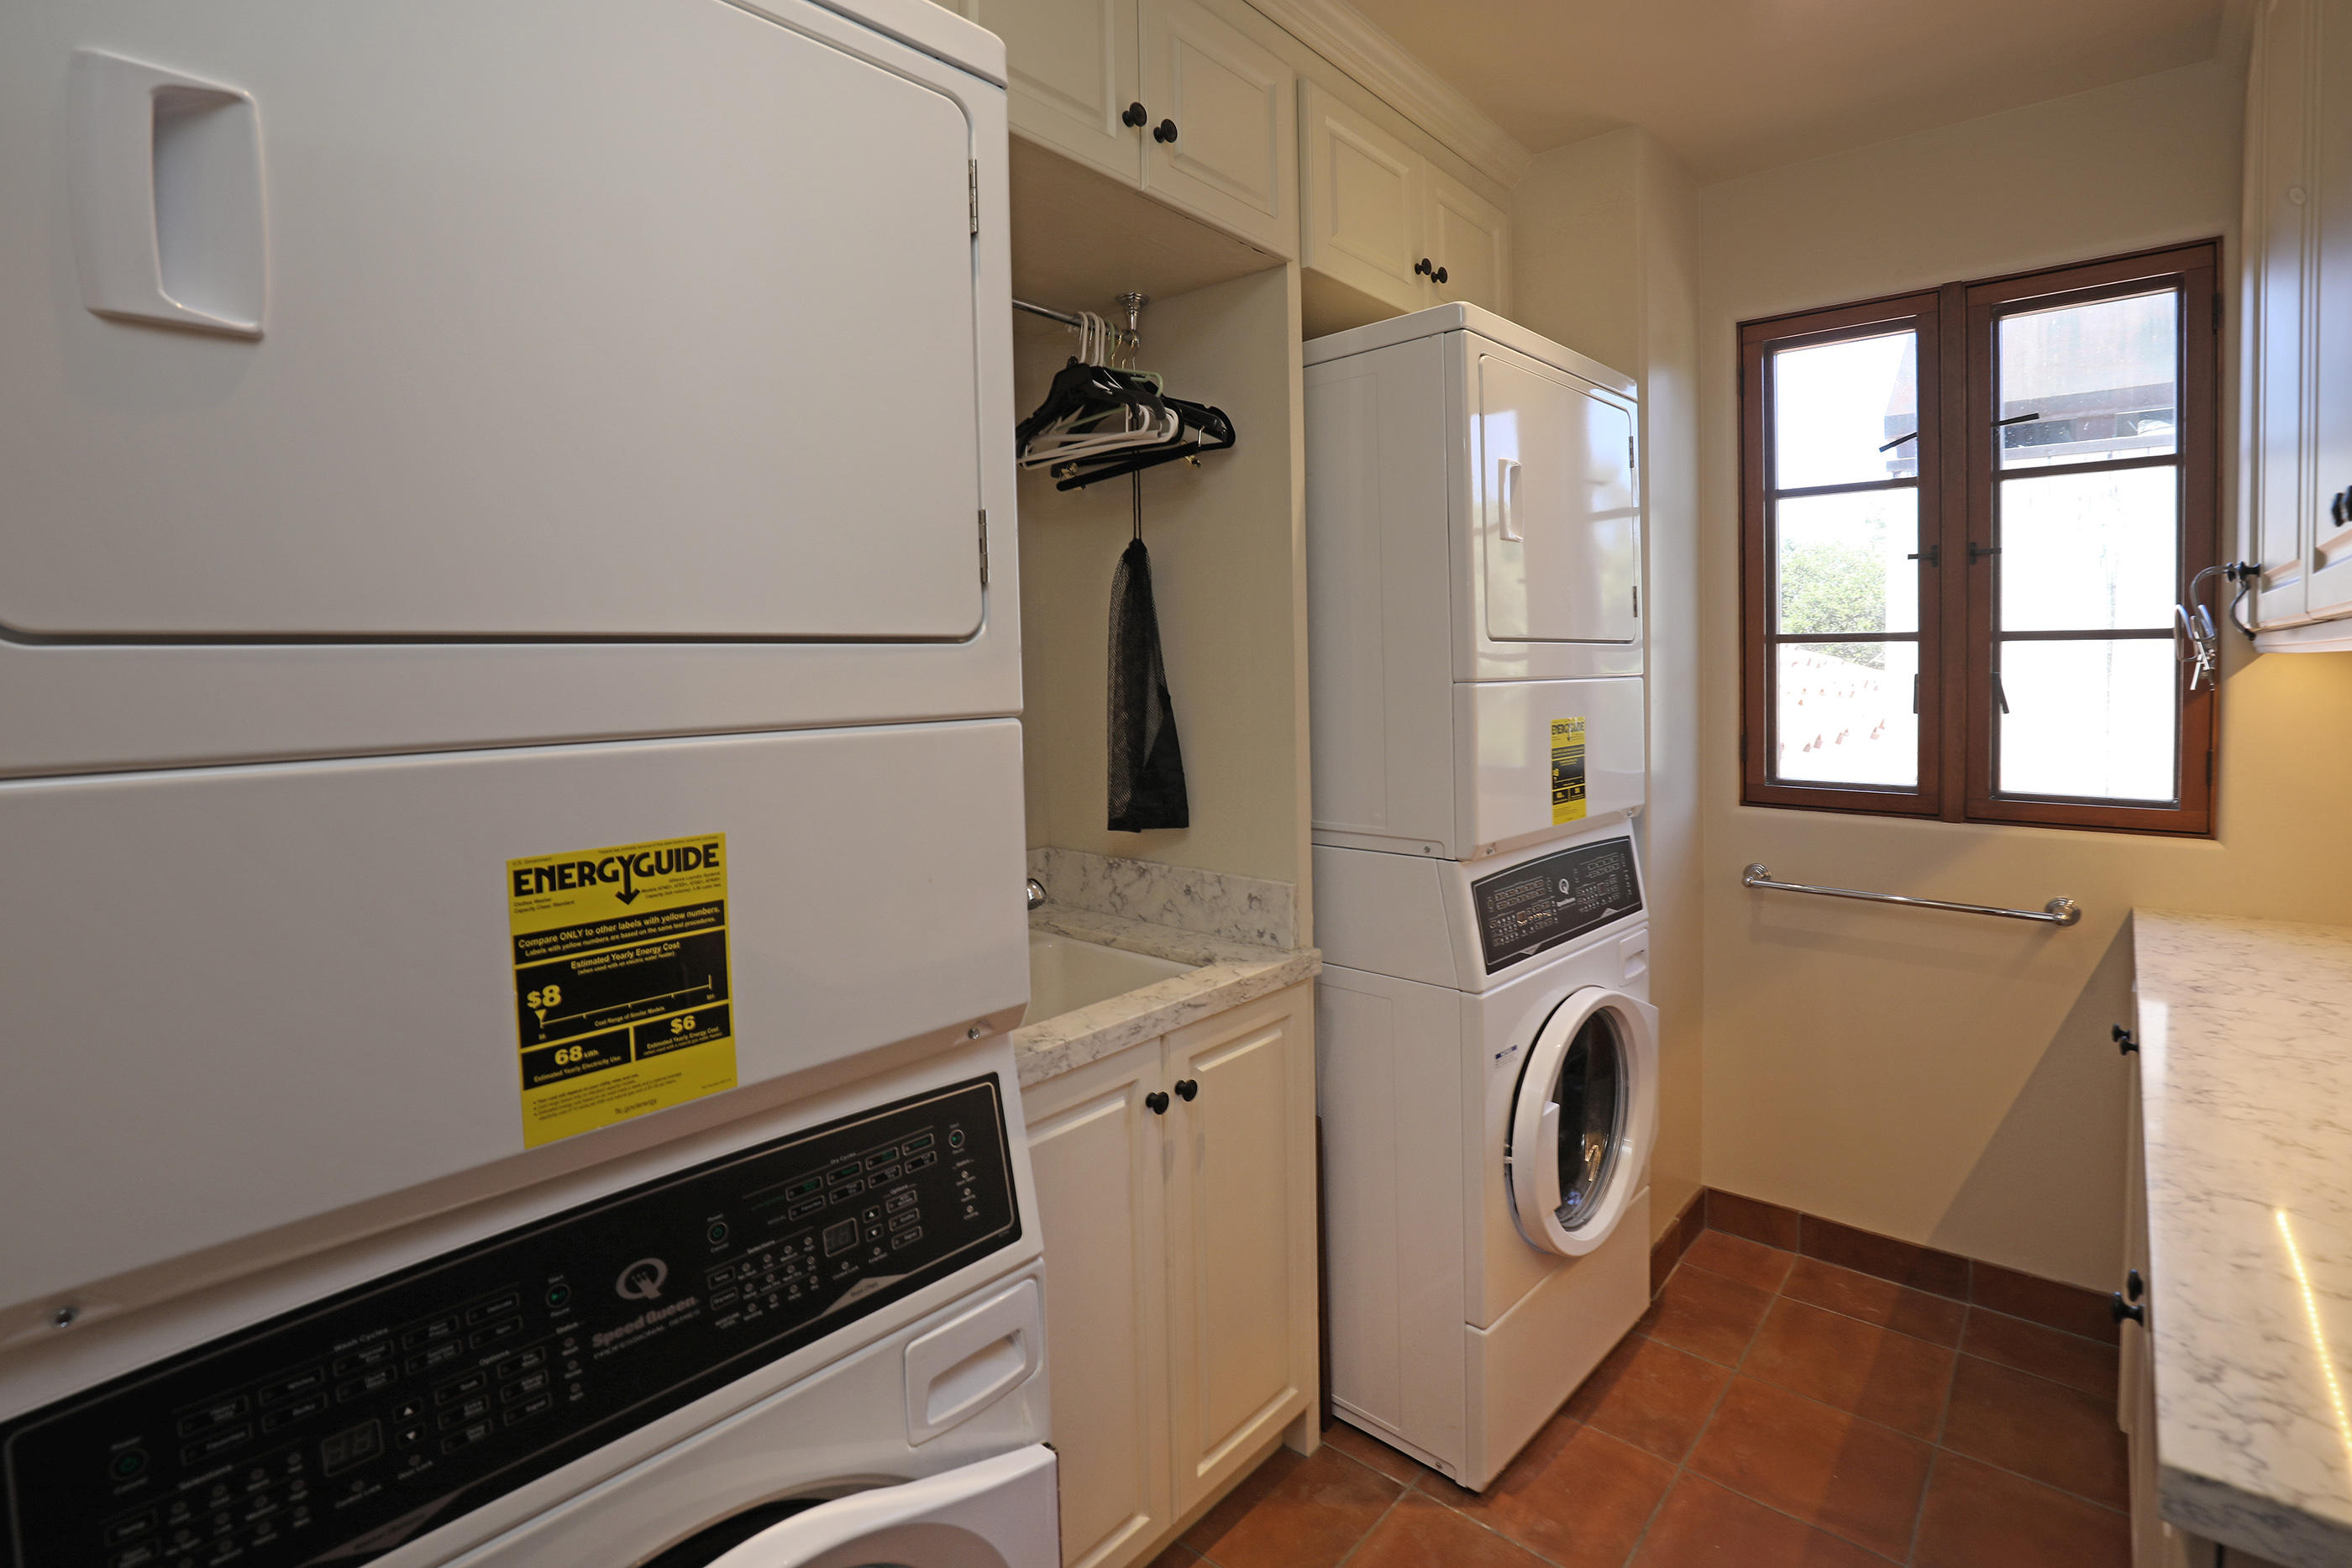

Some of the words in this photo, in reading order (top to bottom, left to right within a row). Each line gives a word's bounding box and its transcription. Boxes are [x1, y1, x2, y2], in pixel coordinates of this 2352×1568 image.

[512, 842, 720, 899] ENERGYGUIDE
[518, 936, 558, 948] Compare
[559, 929, 583, 941] ONLY
[596, 925, 617, 934] other
[618, 920, 642, 930] labels
[643, 916, 659, 925] with
[661, 912, 685, 923] yellow
[687, 907, 721, 917] numbers.
[525, 947, 547, 957] Labels
[563, 940, 582, 950] yellow
[583, 936, 609, 946] numbers
[621, 931, 638, 939] based
[571, 955, 610, 969] Estimated
[612, 951, 634, 962] Yearly
[636, 946, 661, 957] Energy
[663, 941, 680, 951] Cost
[527, 984, 561, 1009] $8
[646, 1038, 673, 1050] Estimated
[689, 1030, 706, 1039] Energy
[707, 1025, 720, 1034] Cost
[670, 1015, 696, 1035] $6
[554, 1045, 583, 1065] 68
[584, 1049, 599, 1058] kWh
[533, 1070, 564, 1083] Estimated
[564, 1065, 580, 1075] Yearly
[581, 1058, 609, 1070] Electricity
[592, 1315, 645, 1348] Speed
